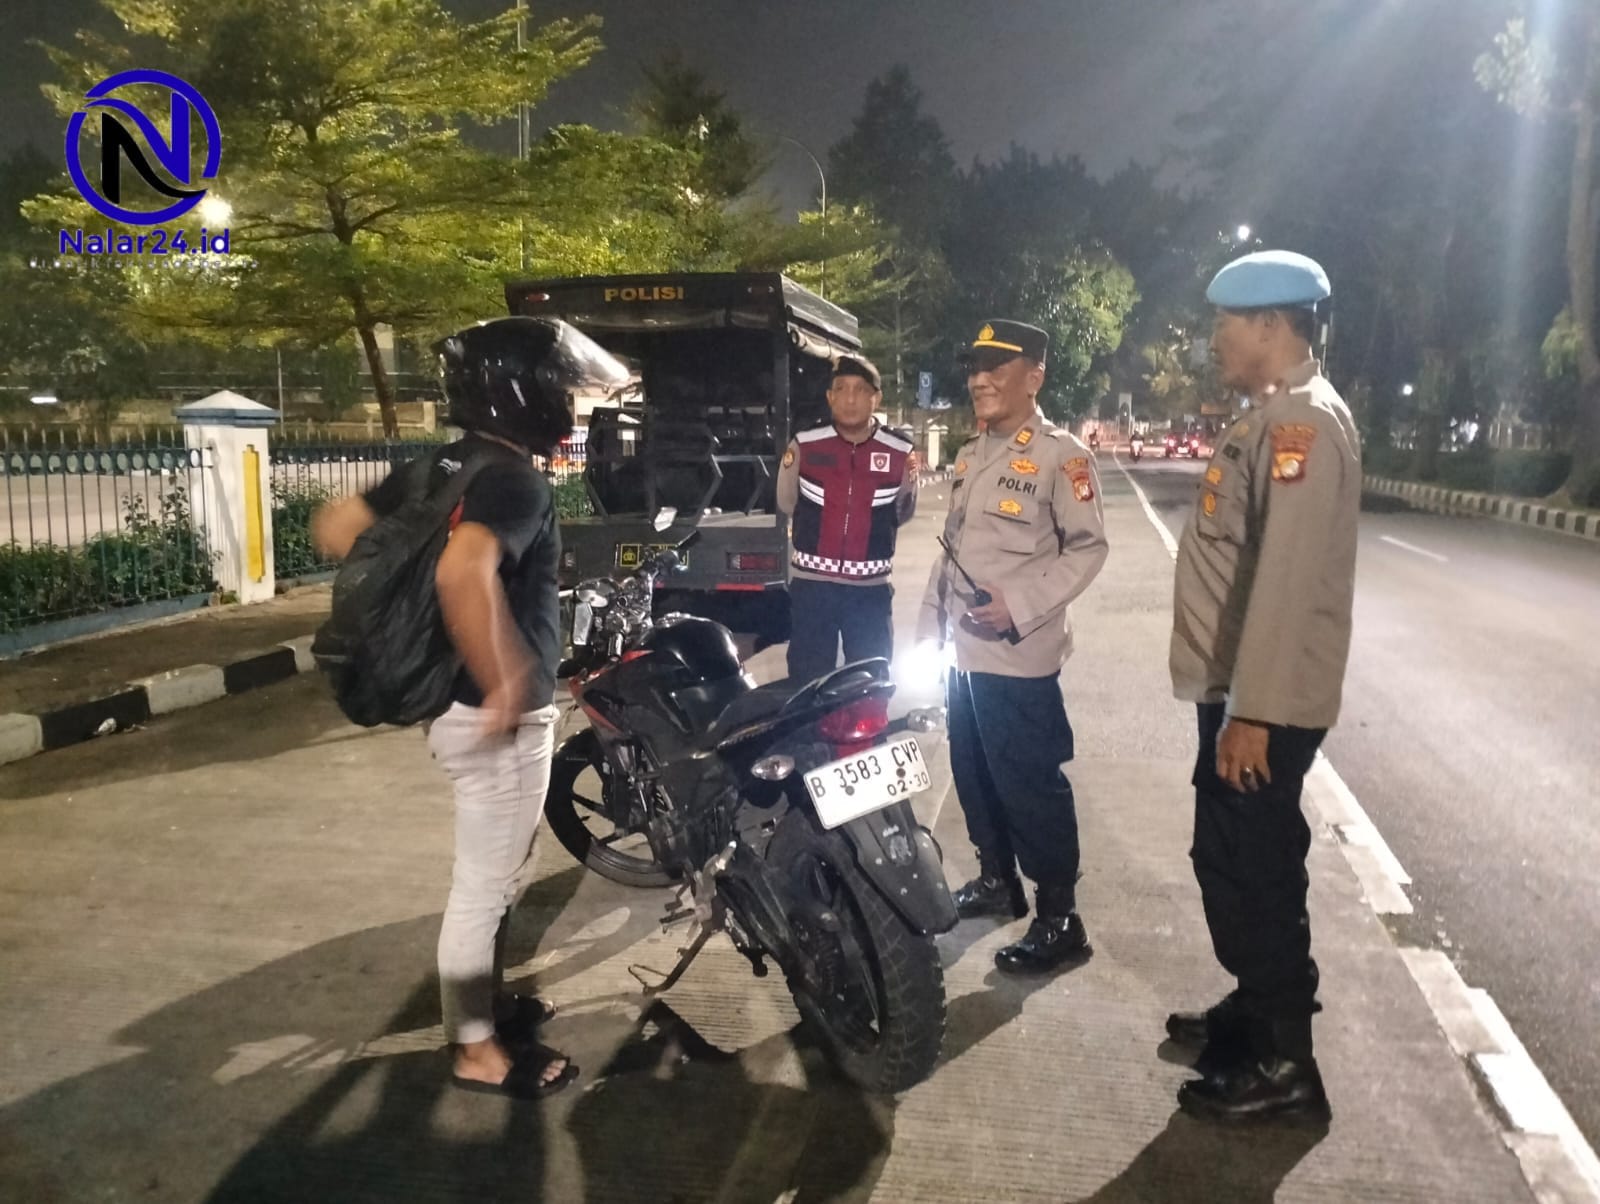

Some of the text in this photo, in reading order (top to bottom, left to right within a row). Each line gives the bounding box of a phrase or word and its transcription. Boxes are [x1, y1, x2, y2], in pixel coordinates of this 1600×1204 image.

[605, 287, 685, 302] POLISI
[997, 476, 1037, 496] POLRI
[810, 741, 918, 798] B 3583 CVP
